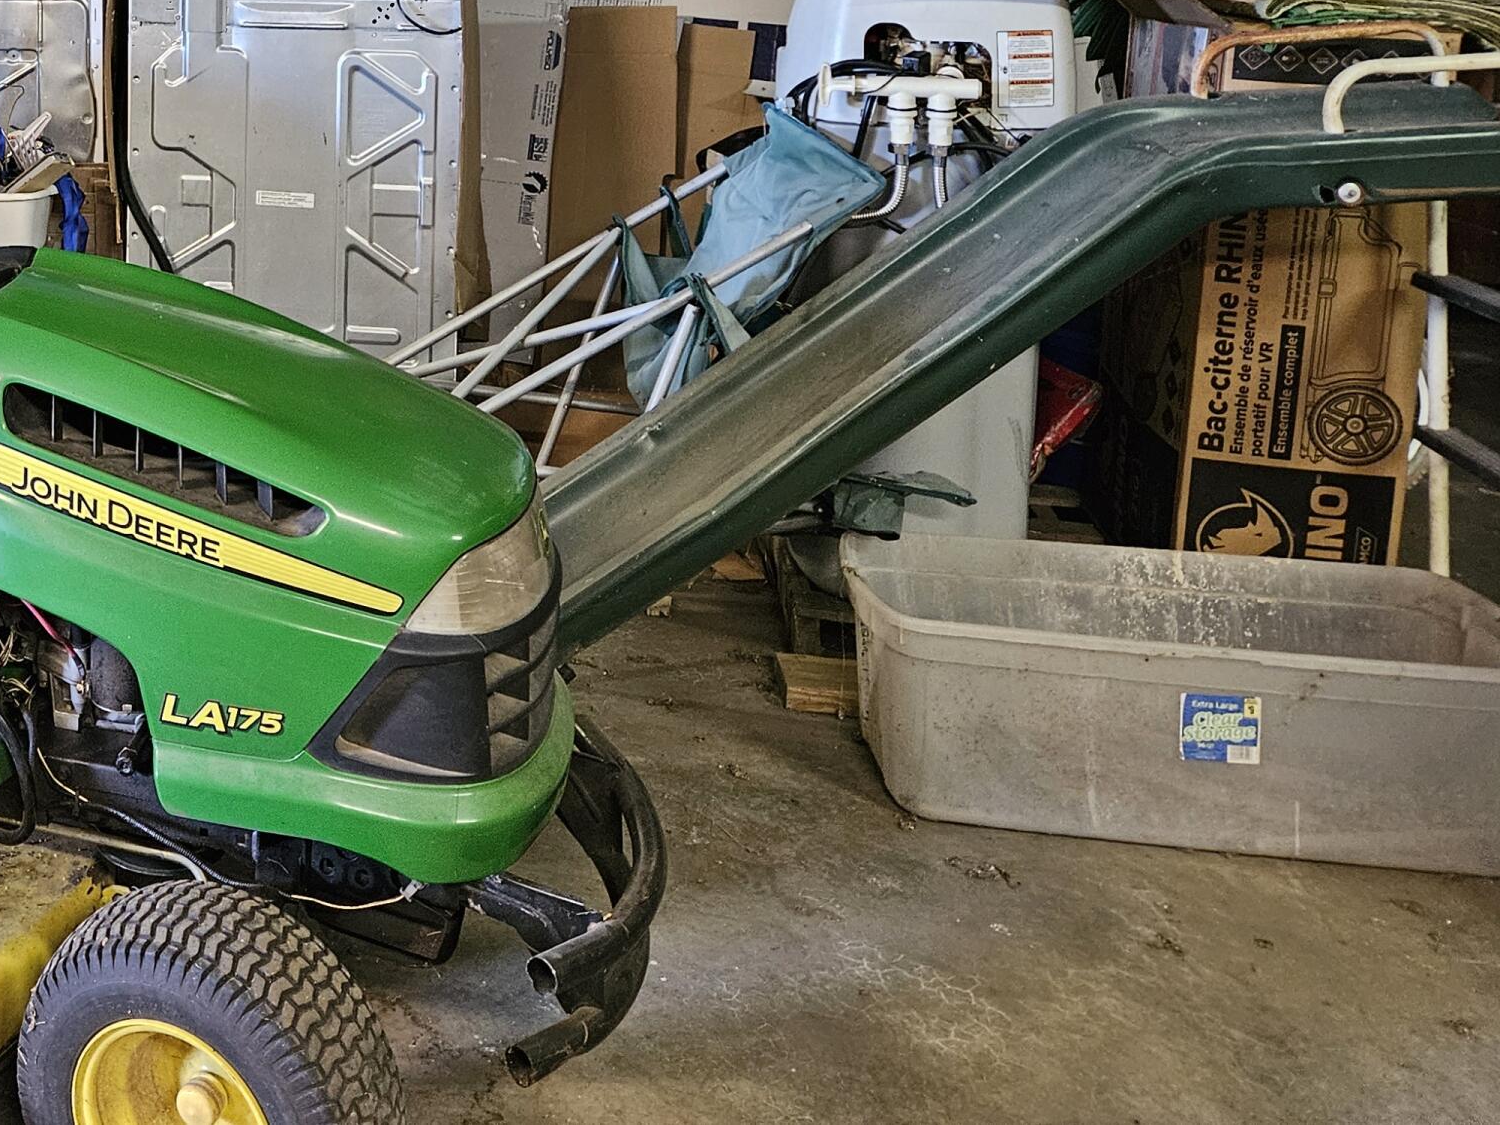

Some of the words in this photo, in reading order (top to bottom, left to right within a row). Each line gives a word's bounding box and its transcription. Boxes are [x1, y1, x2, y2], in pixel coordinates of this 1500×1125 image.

[1247, 246, 1263, 294] d'eaux
[1241, 297, 1258, 357] réservoir
[1198, 291, 1240, 452] Bac-citerne
[1237, 364, 1252, 383] de
[1259, 341, 1274, 368] VR
[1258, 370, 1272, 402] pour
[1273, 388, 1291, 454] Ensemble
[1284, 331, 1299, 386] complet
[1229, 386, 1249, 455] Ensemble
[1251, 403, 1267, 457] portatif
[11, 466, 98, 520] JOHN
[107, 498, 221, 562] DEERE
[159, 693, 285, 735] LA175
[1192, 700, 1214, 709] Extra
[1215, 701, 1239, 711] Large
[1194, 712, 1242, 726] Clear
